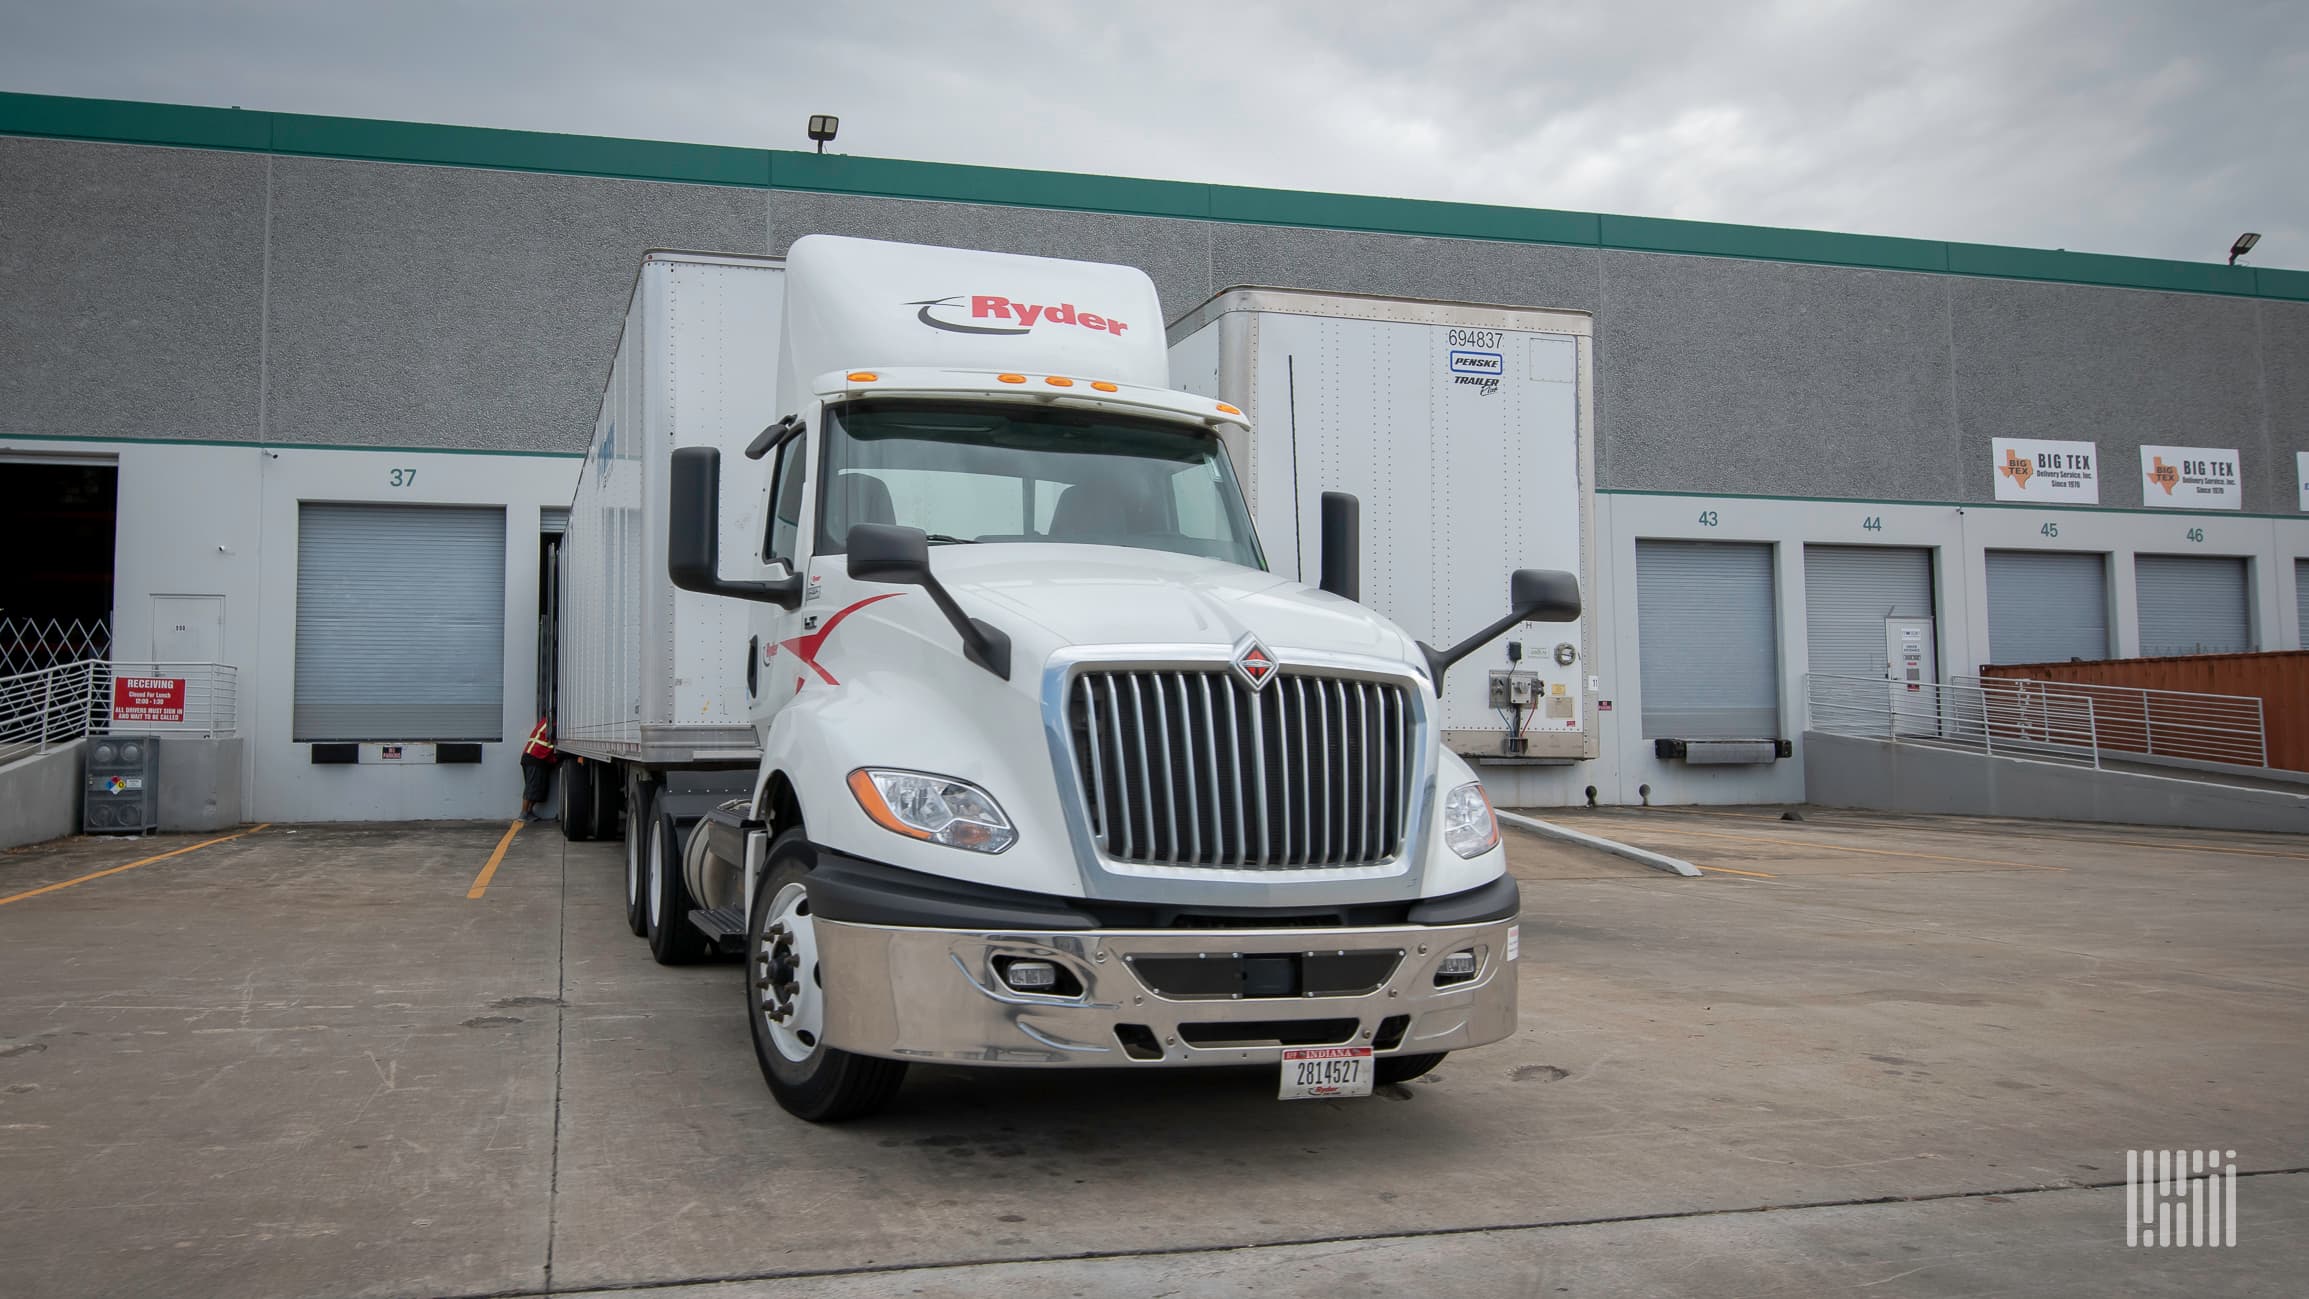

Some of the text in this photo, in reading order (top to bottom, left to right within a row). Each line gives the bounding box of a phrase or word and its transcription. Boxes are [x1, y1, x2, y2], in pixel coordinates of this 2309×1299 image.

[972, 295, 1128, 336] Ryder
[1448, 329, 1503, 349] 694837
[1455, 357, 1499, 368] PENSKE
[1454, 375, 1500, 386] TRAILER
[2009, 459, 2027, 467] BIG
[2038, 453, 2090, 470] BIG TEX
[2183, 460, 2234, 477] BIG TEX
[390, 468, 417, 487] 37
[2008, 467, 2028, 475] TEX
[2036, 470, 2060, 478] Delivery
[2156, 466, 2173, 474] BIG
[2156, 474, 2175, 482] TEX
[1698, 510, 1718, 526] 43
[1863, 516, 1882, 532] 44
[2040, 522, 2058, 537] 45
[2186, 527, 2204, 543] 46
[127, 678, 174, 689] RECEIVING
[1306, 1048, 1352, 1059] INDIANA
[1297, 1059, 1360, 1085] 2814527
